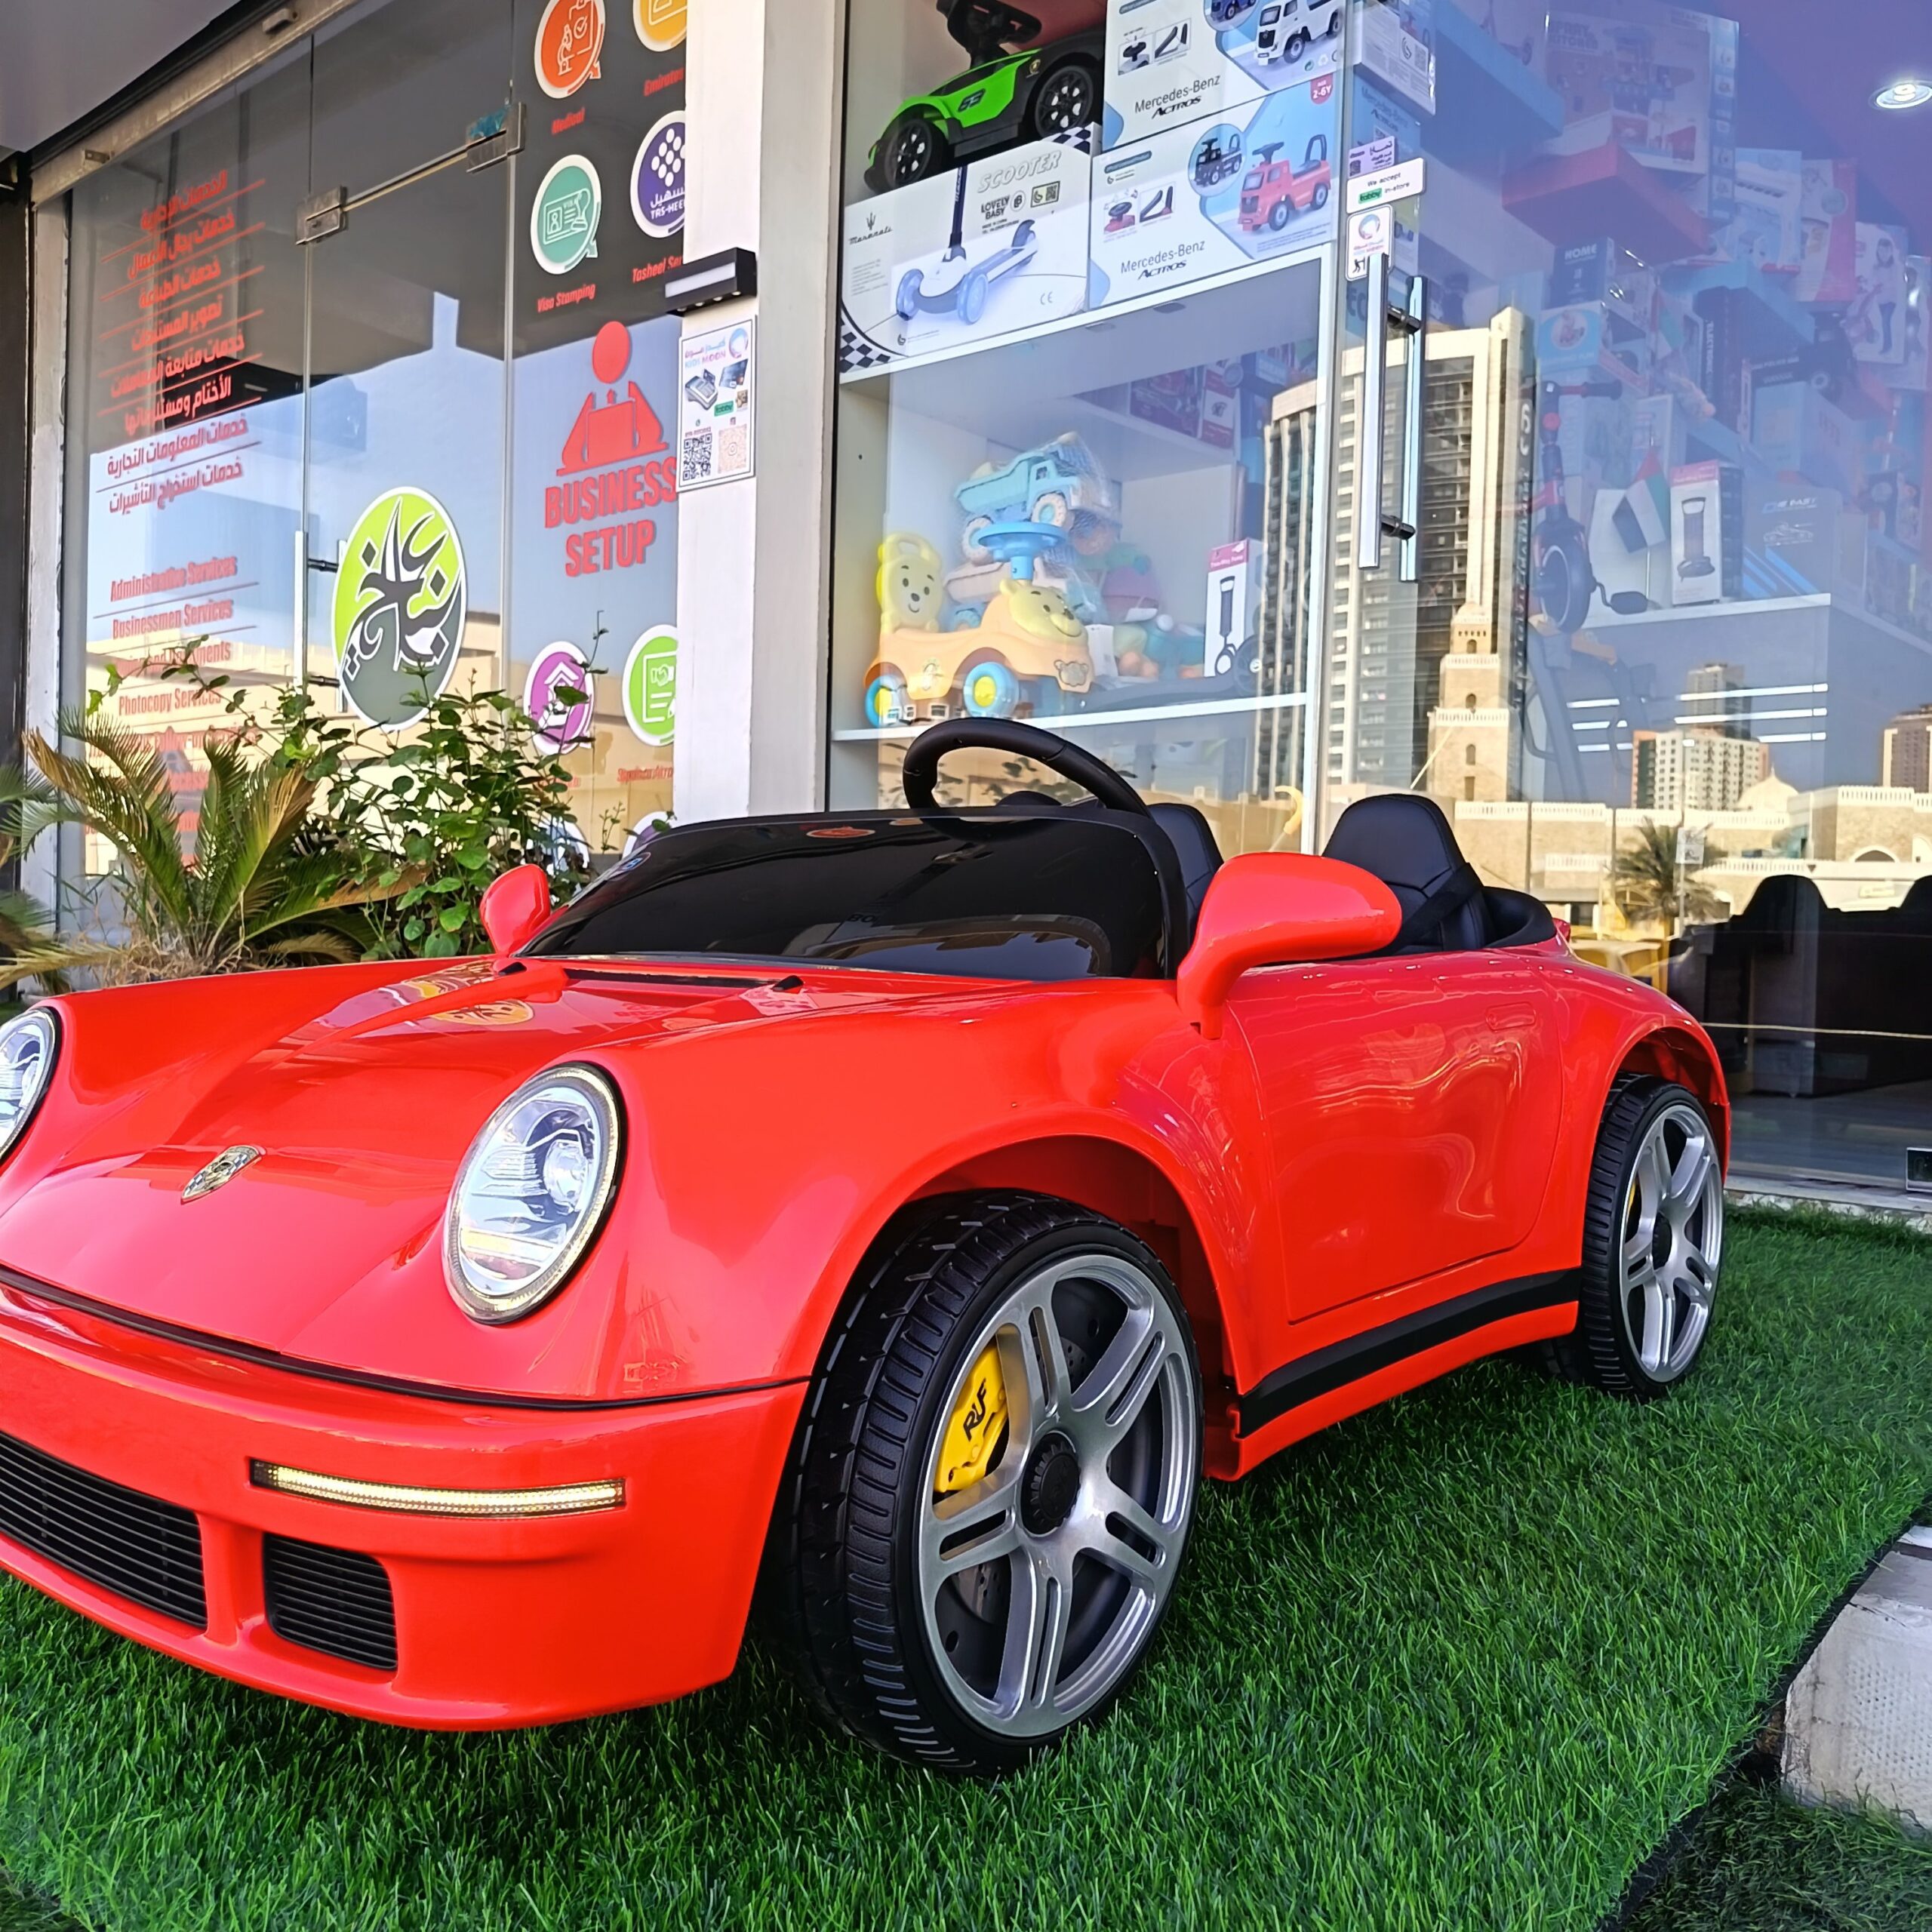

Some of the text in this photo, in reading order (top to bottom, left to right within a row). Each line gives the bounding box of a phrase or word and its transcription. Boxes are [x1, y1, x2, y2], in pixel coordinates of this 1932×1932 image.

[1134, 75, 1220, 113] Mercedes-Benz
[1312, 85, 1332, 99] 2-6Y
[552, 106, 586, 136] Medical
[977, 149, 1062, 193] SCOOTER
[1367, 172, 1401, 187] We accept
[981, 195, 1010, 213] LOVELY
[1359, 182, 1410, 202] tabby in-store
[195, 208, 235, 243] خدمات
[986, 206, 1006, 220] BABY
[1120, 241, 1205, 274] Mercedes-Benz
[1564, 244, 1597, 260] HOME
[180, 256, 220, 291] خدمات
[632, 258, 666, 283] Tasheel
[191, 294, 223, 333] تصوير
[537, 284, 596, 313] Visa Stamping
[205, 328, 245, 362] خدمات
[702, 351, 726, 363] MOON
[165, 349, 202, 377] متابعة
[192, 374, 232, 419] الأختام
[108, 413, 248, 479] خدمات المعلومات التجارية
[109, 457, 243, 515] خدمات استخراج التأشيرات
[545, 457, 677, 528] BUSINESS
[565, 519, 656, 577] SETUP
[111, 556, 238, 601] Administrative Services
[113, 599, 233, 639] Businessmen Services
[119, 693, 172, 716] Photocopy
[963, 1377, 987, 1442] RUF
